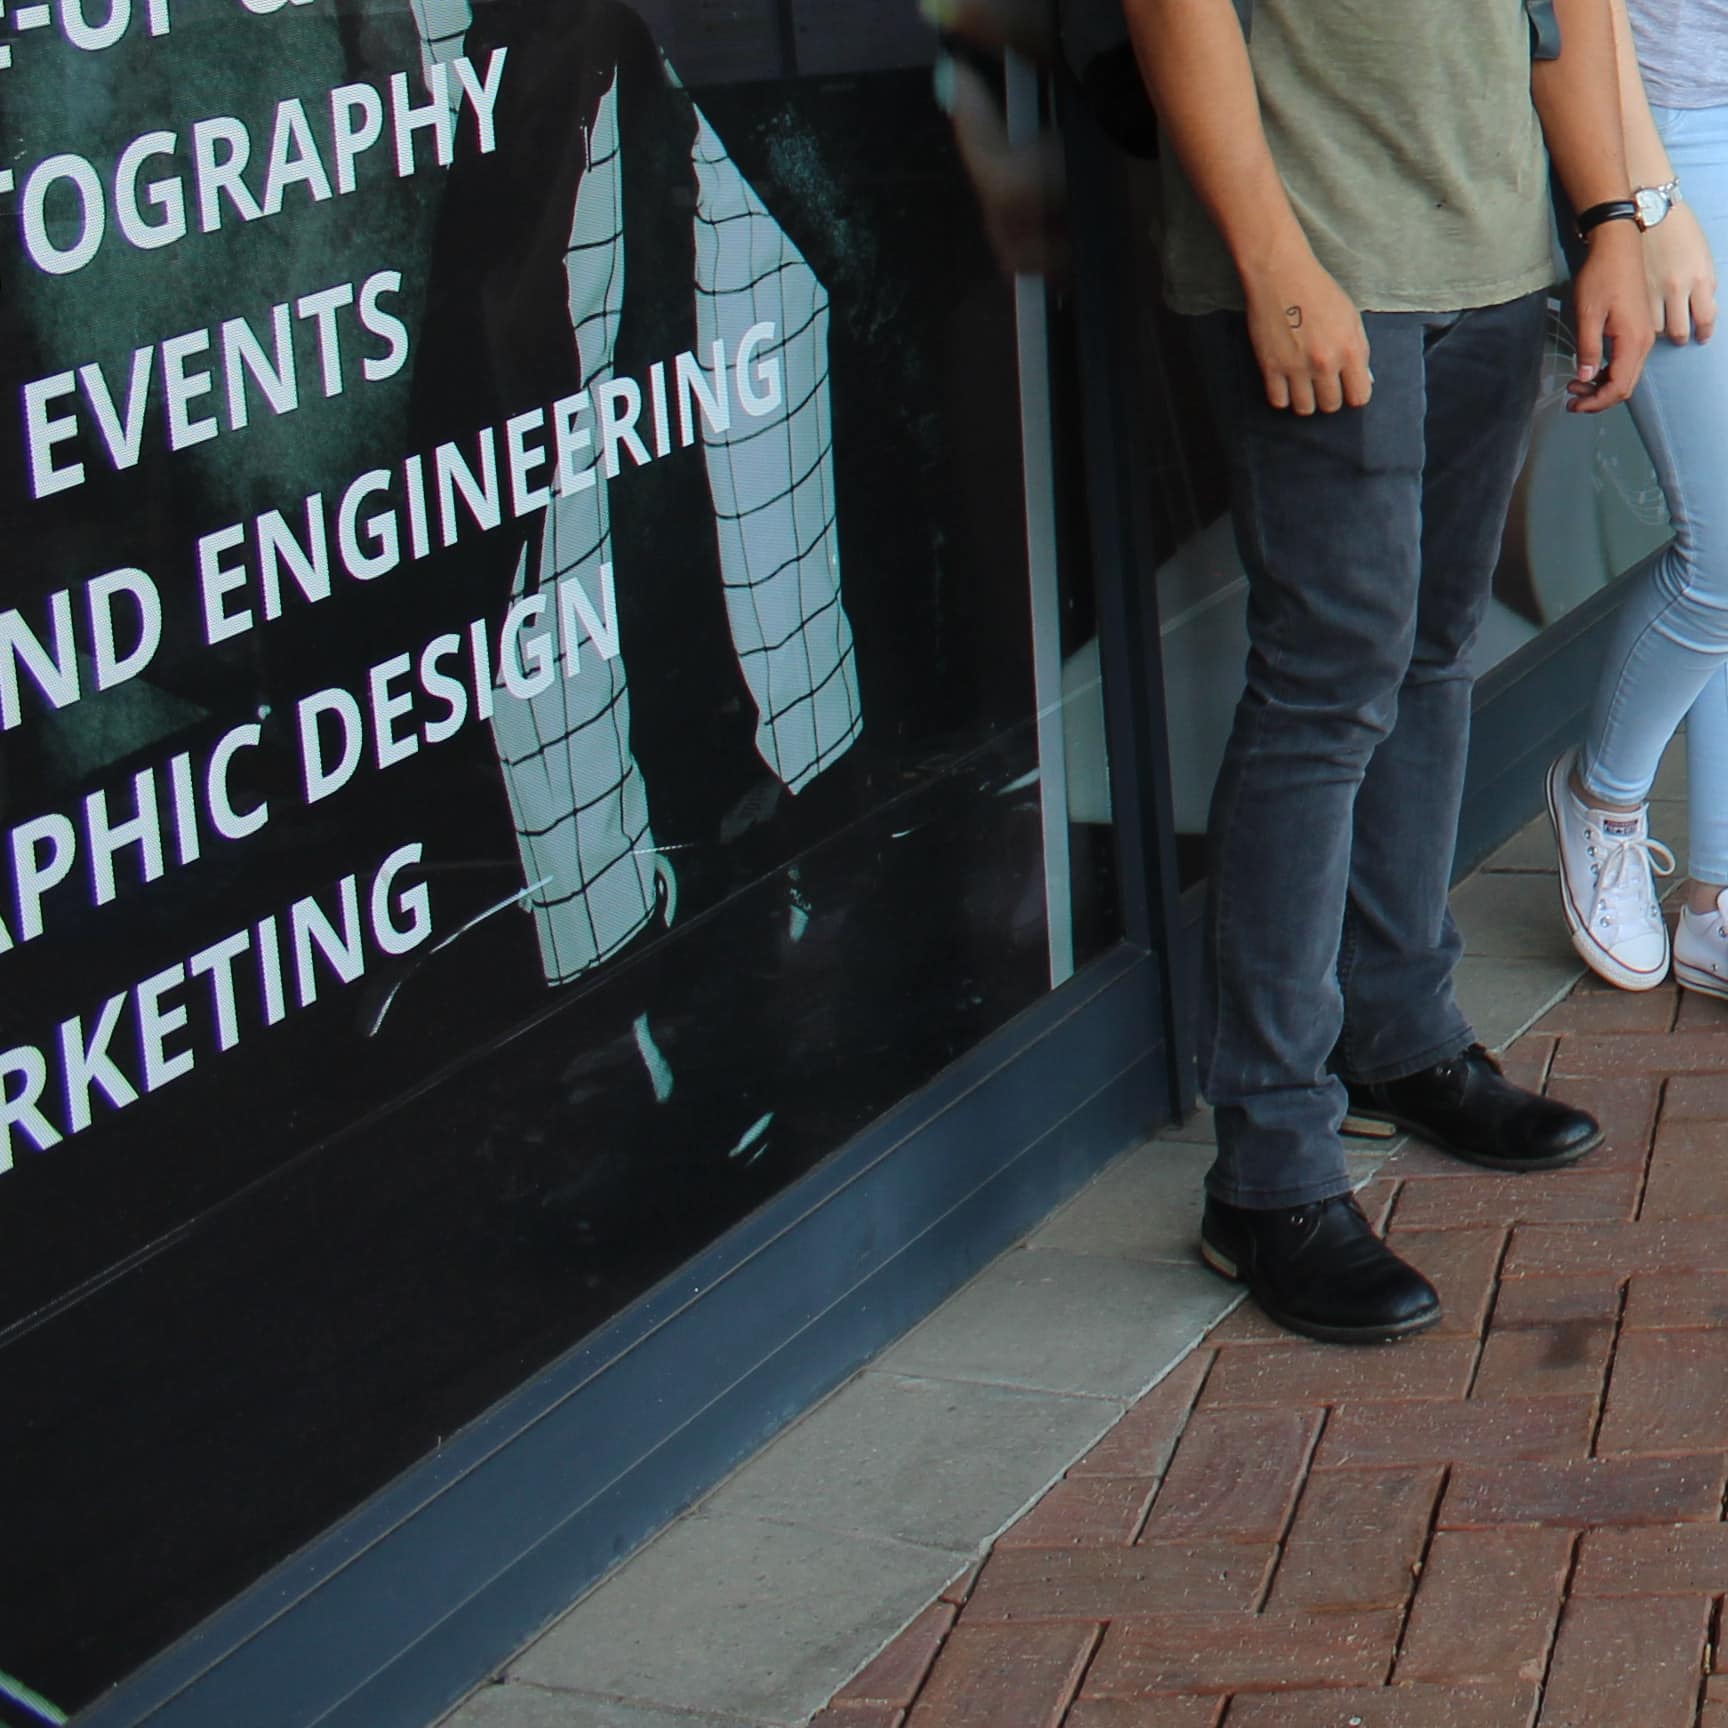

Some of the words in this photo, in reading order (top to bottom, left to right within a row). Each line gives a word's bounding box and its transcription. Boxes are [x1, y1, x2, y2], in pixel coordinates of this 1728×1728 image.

[0, 46, 508, 275] OGRAPHY
[23, 269, 409, 500] EVENTS
[197, 320, 783, 646] ENGINEERING
[0, 723, 268, 952] PHIC
[297, 562, 620, 806] DESIGN
